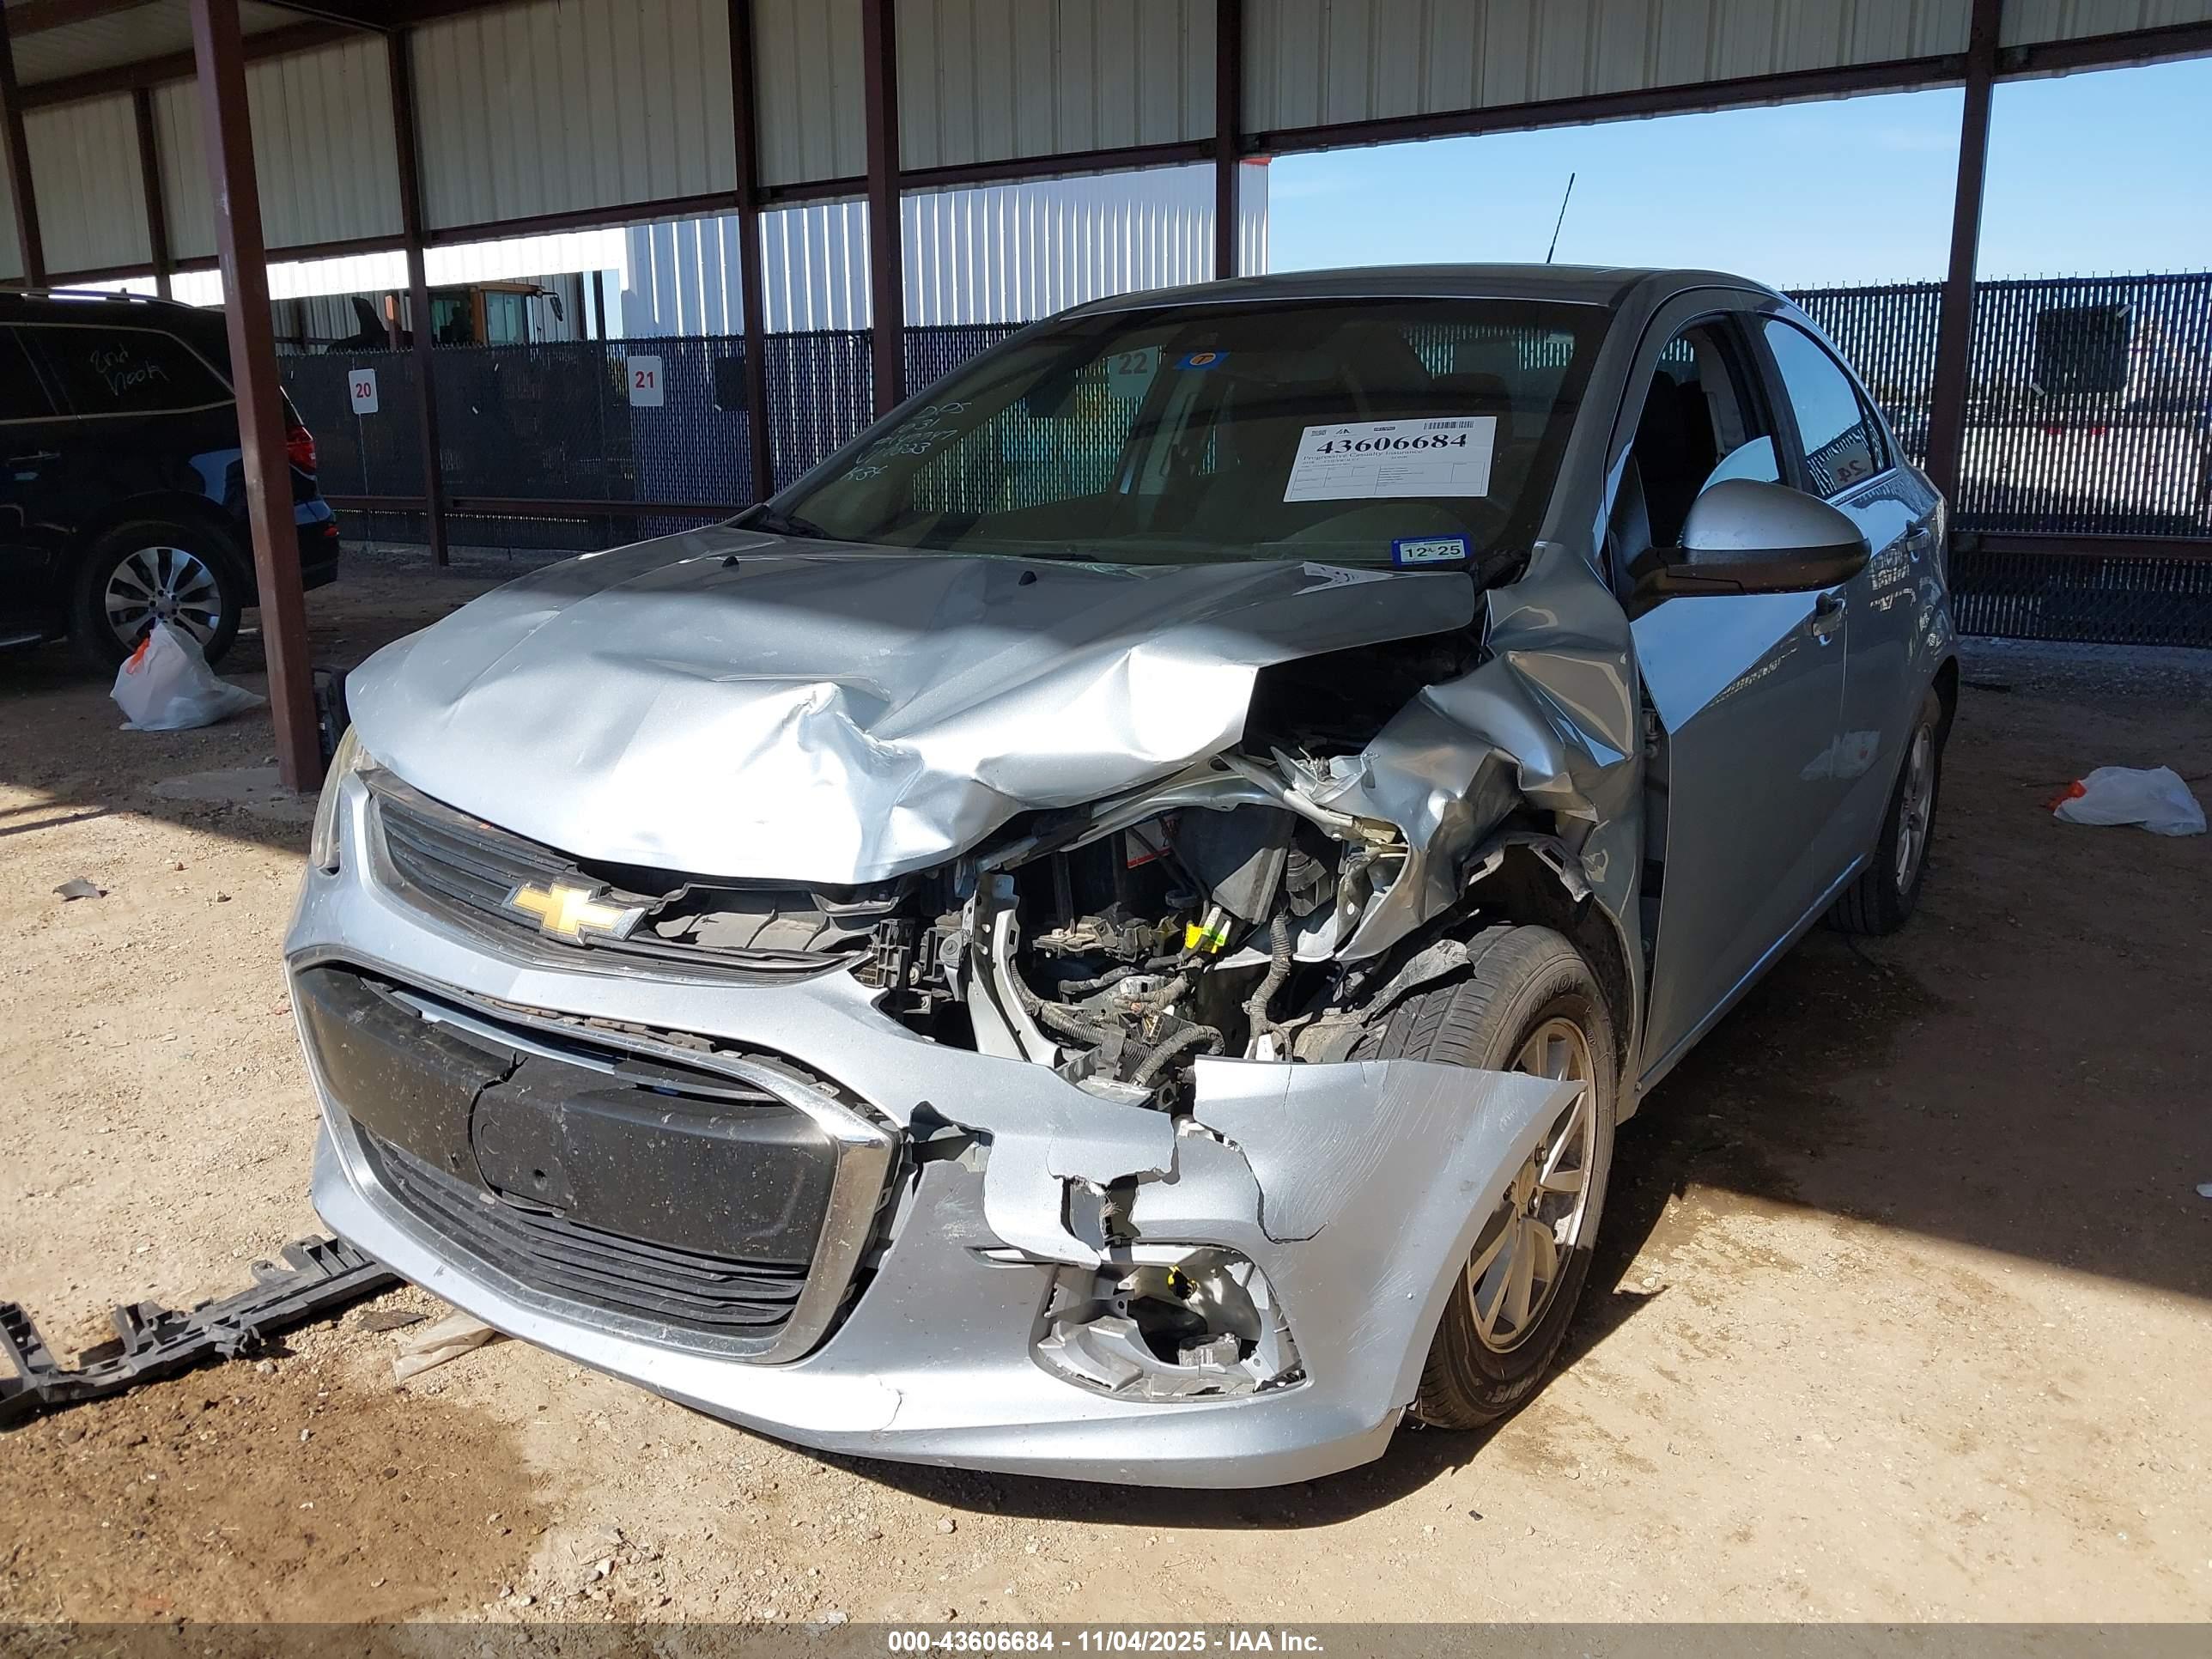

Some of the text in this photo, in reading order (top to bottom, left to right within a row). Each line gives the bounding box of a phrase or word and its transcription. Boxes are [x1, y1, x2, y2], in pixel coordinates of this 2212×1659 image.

[1119, 352, 1148, 374] 22
[635, 370, 655, 389] 21
[356, 381, 372, 398] 20
[1317, 434, 1468, 454] 43606684
